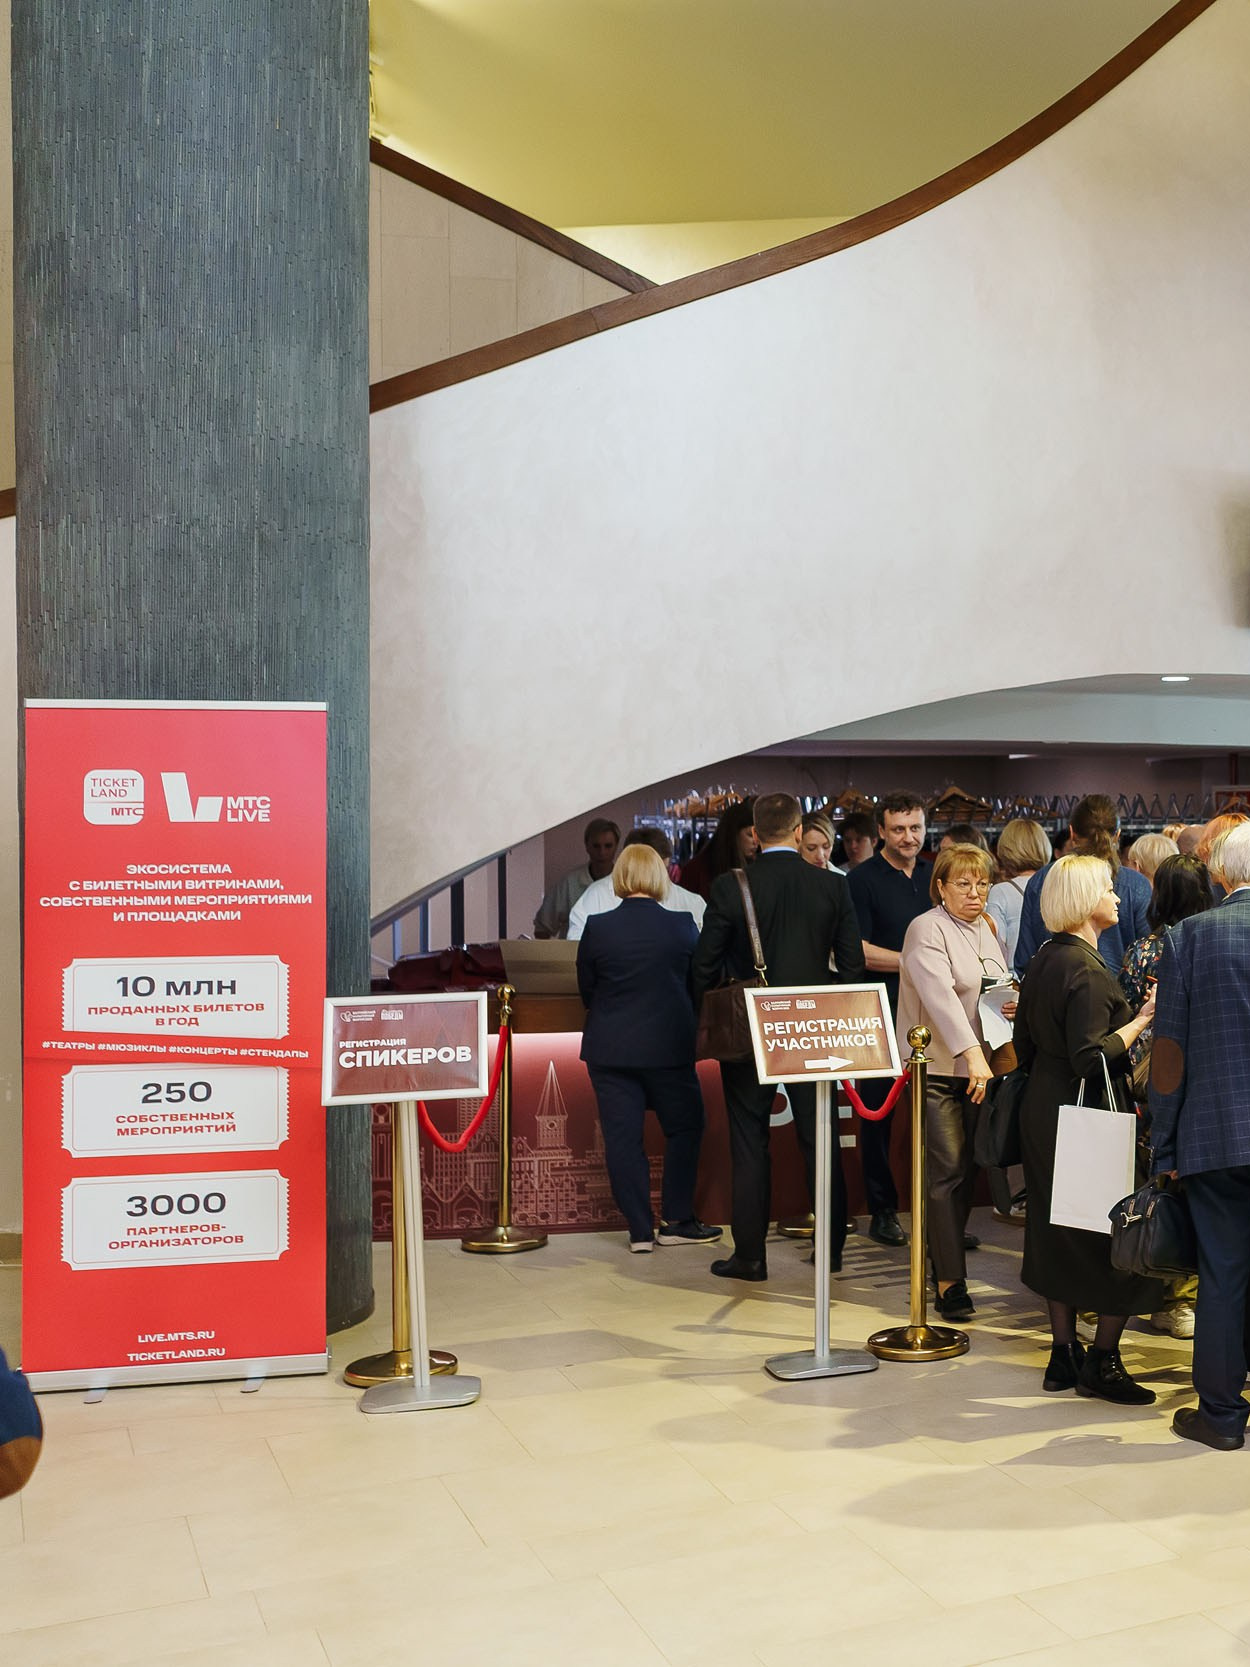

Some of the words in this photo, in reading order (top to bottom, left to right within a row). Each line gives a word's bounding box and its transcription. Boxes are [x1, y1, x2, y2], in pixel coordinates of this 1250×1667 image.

[91, 778, 137, 787] TICKET
[91, 788, 127, 798] LAND
[227, 810, 270, 822] LIVE
[127, 864, 231, 874] ЭКОСИСТЕМА
[69, 880, 80, 891] С
[83, 880, 182, 890] БИЛЕТНЫМИ
[185, 879, 284, 890] ВИТРИНАМИ,
[40, 895, 172, 906] СОБСТВЕННЫМИ
[174, 894, 312, 905] МЕРОПРИЯТИЯМИ
[113, 912, 124, 922] И
[127, 910, 241, 922] ПЛОЩАДКАМИ
[116, 976, 155, 997] 10
[88, 1004, 189, 1016] ПРОДАННЫХ
[193, 1003, 265, 1013] БИЛЕТОВ
[155, 1016, 164, 1026] В
[168, 1016, 199, 1028] ГОД
[763, 1017, 882, 1035] РЕГИСТРАЦИЯ
[339, 1038, 406, 1048] РЕГИСТРАЦИЯ
[765, 1034, 878, 1052] УЧАСТНИКОВ
[42, 1041, 95, 1050] #ТЕАТРЫ
[98, 1042, 166, 1053] #МЮЗИКЛЫ
[169, 1045, 237, 1056] #КОНЦЕРТЫ
[240, 1048, 308, 1058] #СТЕНДАПЫ
[338, 1046, 472, 1068] СПИКЕРОВ
[141, 1081, 212, 1104] 250
[116, 1112, 235, 1123] СОБСТВЕННЫХ
[116, 1122, 236, 1136] МЕРОПРИЯТИЙ
[126, 1192, 226, 1217] 3000
[126, 1224, 226, 1236] ПАРТНЕРОВ-
[108, 1235, 244, 1250] ОРГАНИЗАТОРОВ
[138, 1331, 215, 1343] LIVE.MTS.RU
[128, 1348, 226, 1361] TICKETLAND.RU
